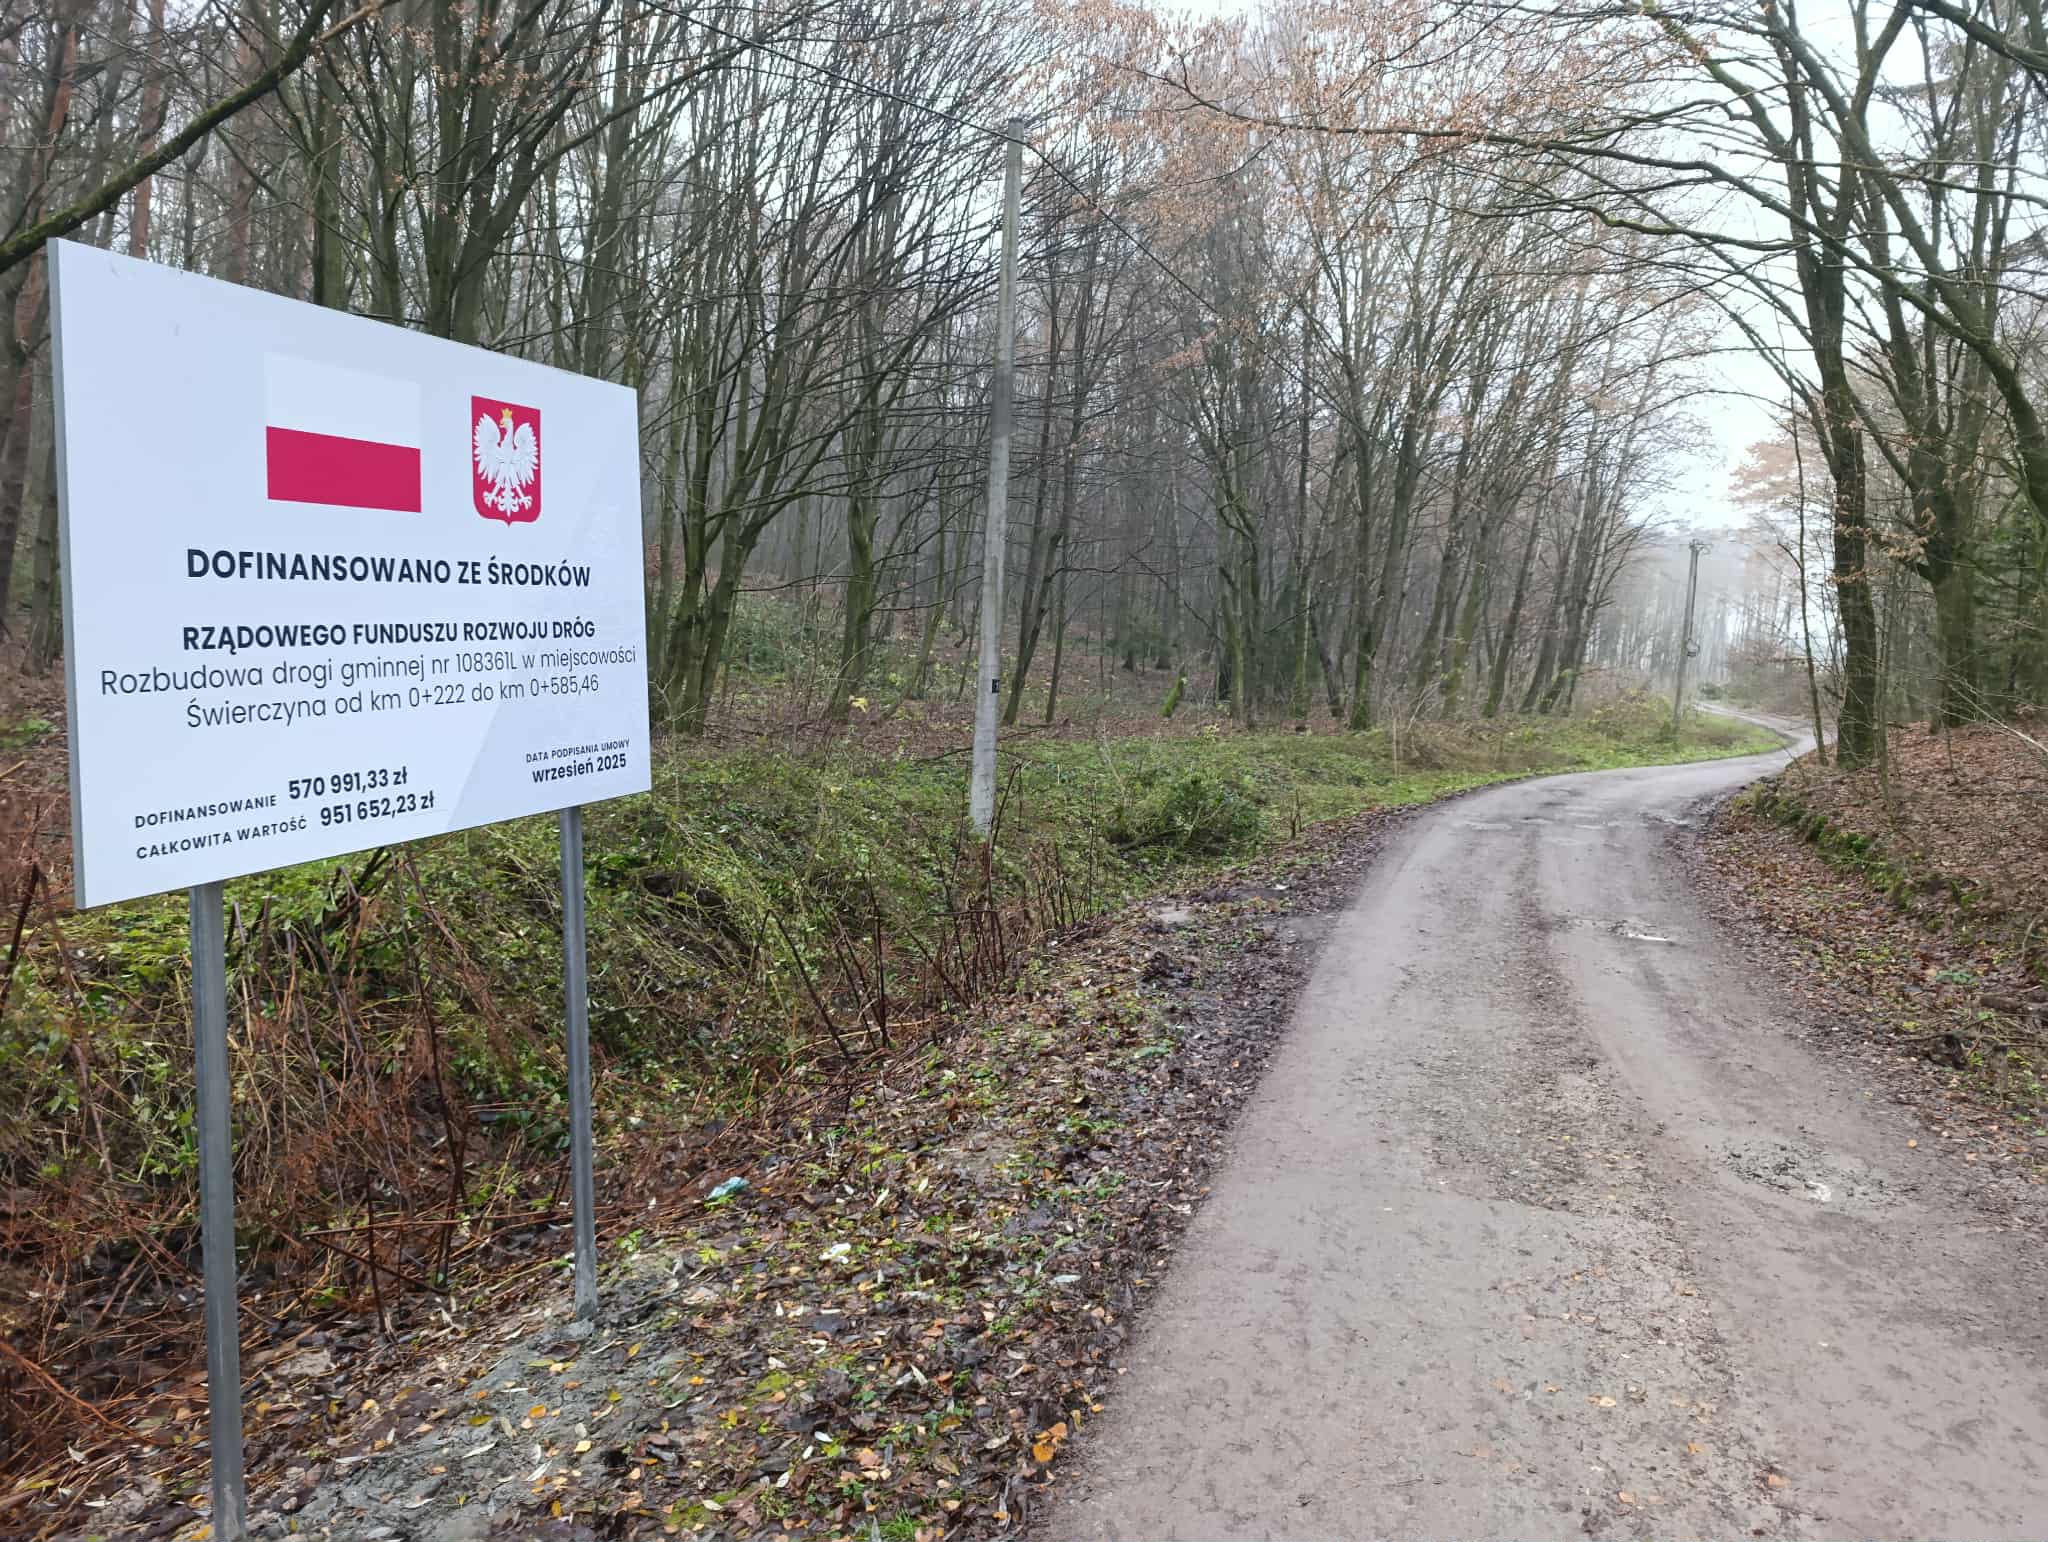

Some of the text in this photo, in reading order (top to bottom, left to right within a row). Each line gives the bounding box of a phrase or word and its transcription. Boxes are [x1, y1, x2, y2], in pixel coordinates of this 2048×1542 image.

[187, 549, 590, 587] DOFINANSOWANO ZE ŚRODKÓW
[183, 616, 595, 655] RZĄDOWEGO FUNDUSZU ROZWOJU DRÓG
[101, 665, 264, 694] Rozbudowa
[272, 658, 332, 689] drogi
[341, 655, 424, 686] gminnej
[432, 658, 450, 675] nr
[521, 654, 535, 669] w
[540, 646, 637, 672] miejscowości
[187, 673, 598, 727] Świerczyna od km 0+222 do km 0+585,46
[526, 738, 629, 763] DATA PODPISANIA UMOWY
[532, 753, 626, 783] wrzesień 2025
[135, 766, 407, 828] DOFINANSOWANIE 570 991,33 zł
[136, 790, 434, 859] CAŁKOWITA WARTOŚĆ 951 652,23 zł
